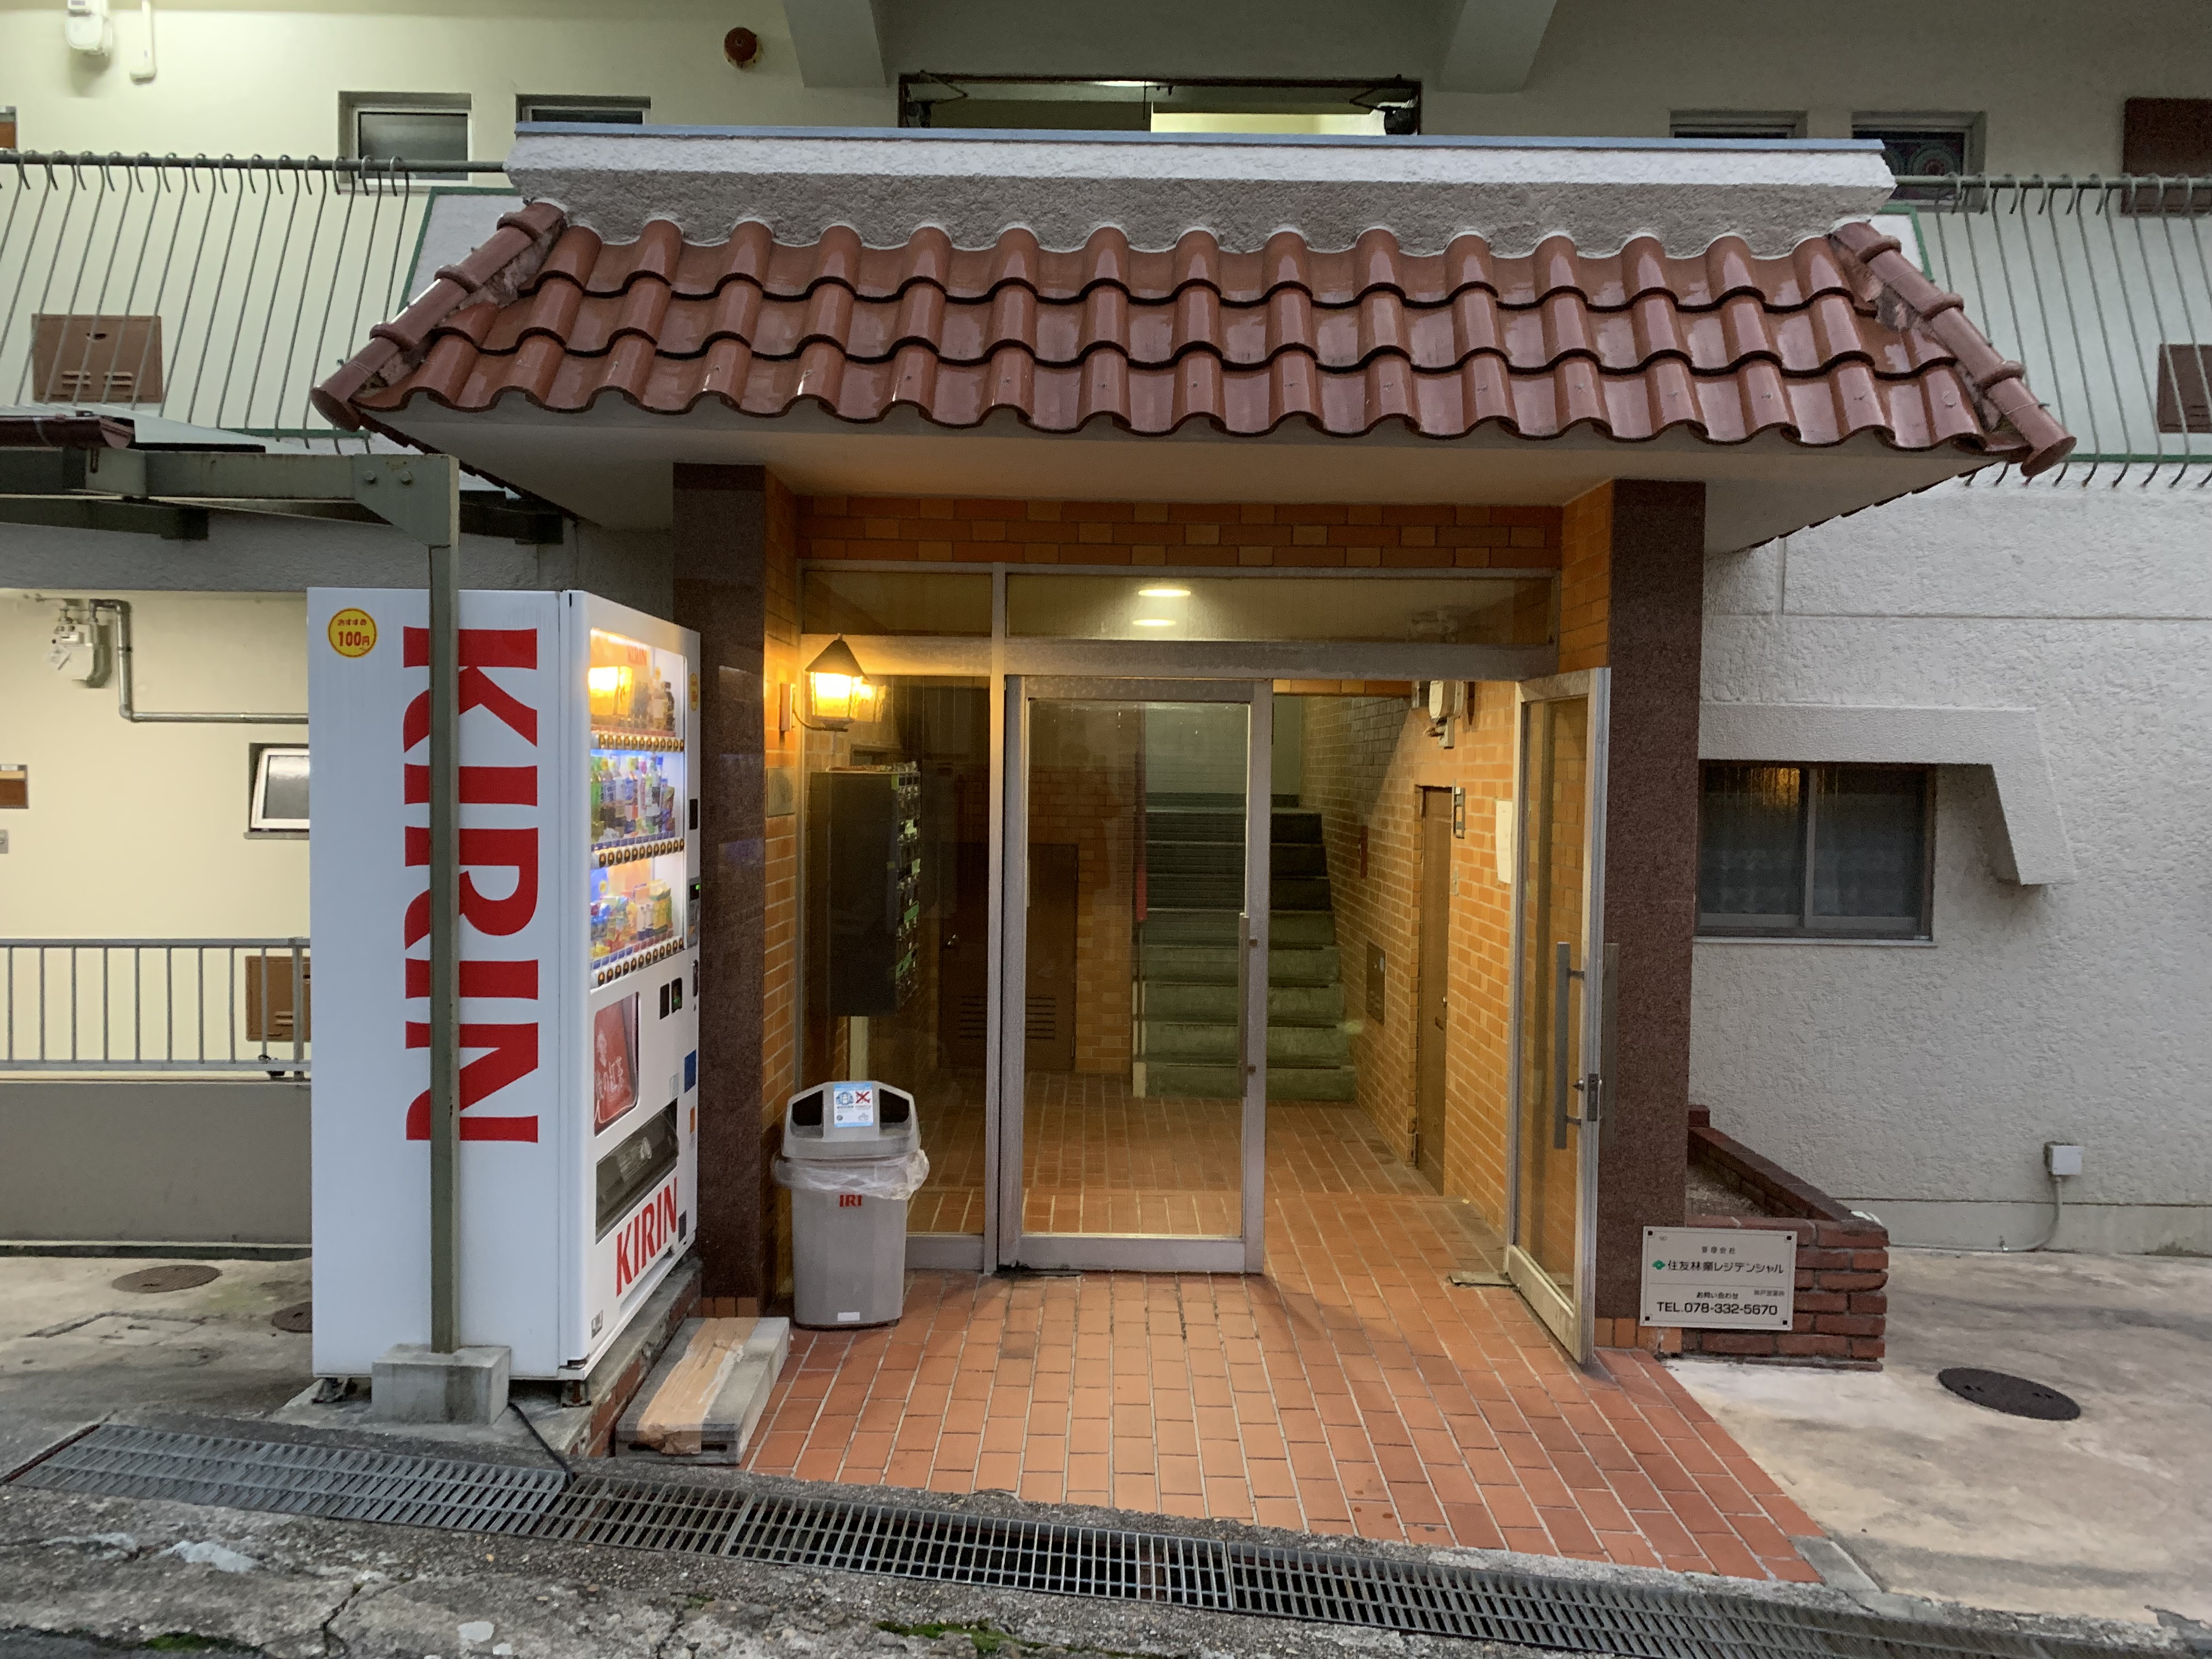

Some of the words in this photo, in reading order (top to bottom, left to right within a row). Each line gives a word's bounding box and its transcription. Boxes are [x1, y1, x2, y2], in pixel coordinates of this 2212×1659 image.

[338, 631, 370, 647] 100円
[403, 626, 539, 1143] KIRIN
[616, 1176, 678, 1298] KIRIN
[1668, 1260, 1783, 1274] 住友林業レジデンシャル
[1696, 1291, 1739, 1300] お問い合わせ
